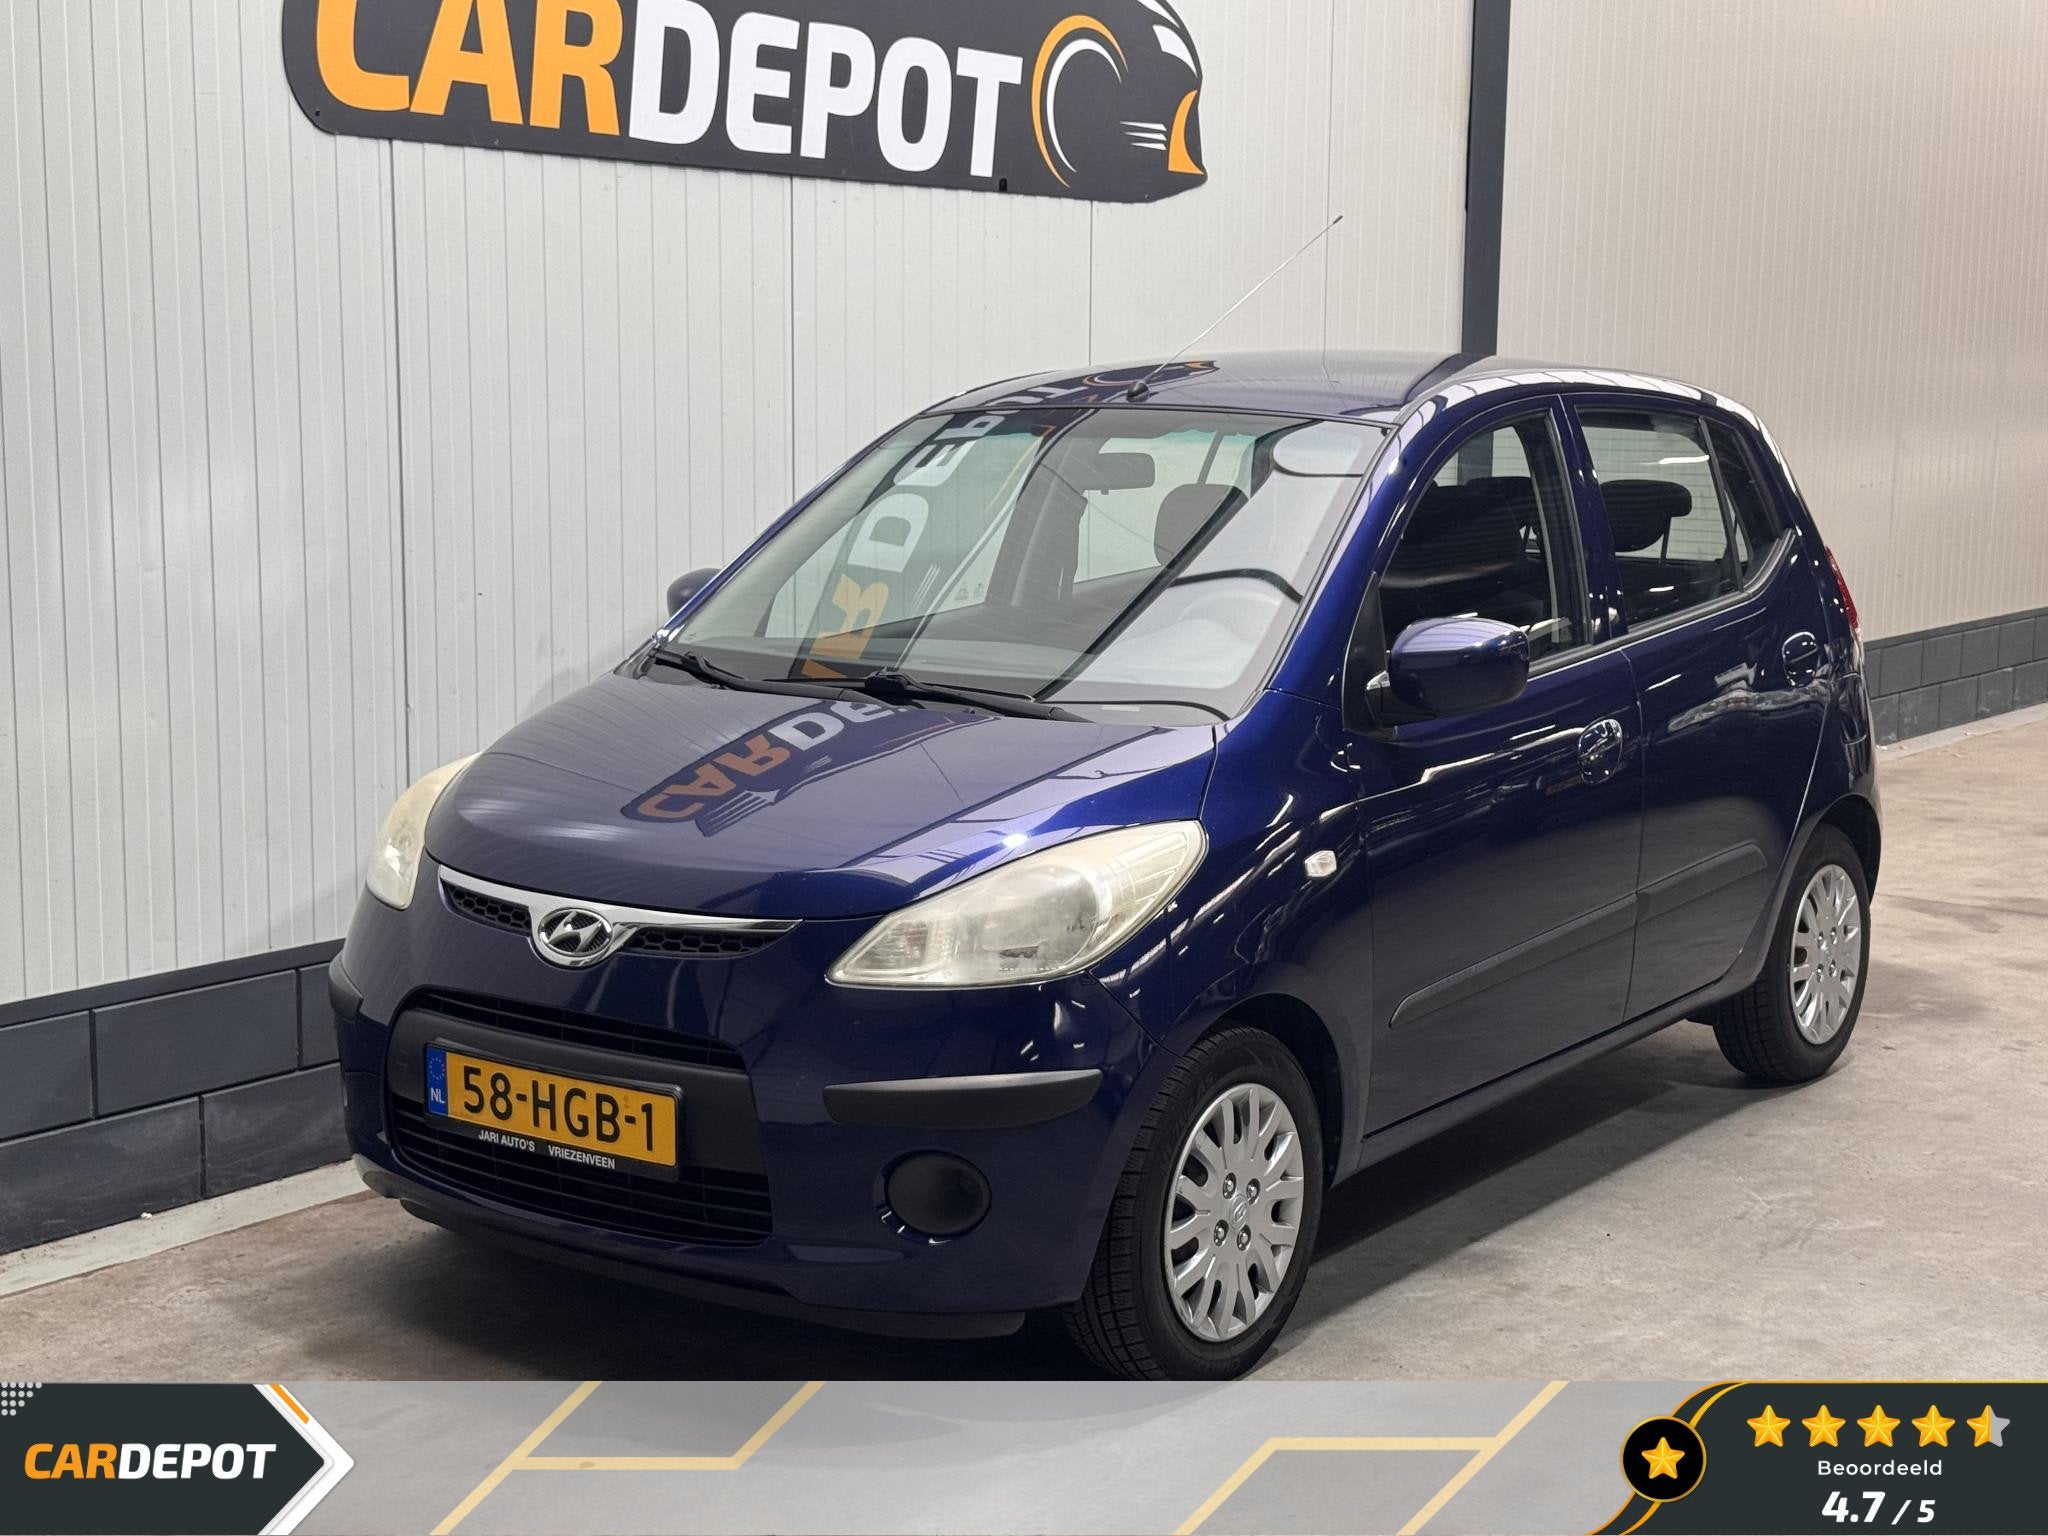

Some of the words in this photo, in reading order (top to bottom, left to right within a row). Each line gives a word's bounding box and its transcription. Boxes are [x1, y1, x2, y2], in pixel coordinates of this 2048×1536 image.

[316, 0, 1023, 179] CARDEPOT
[430, 1087, 446, 1104] NL
[463, 1064, 654, 1152] 58-HGB-1
[478, 1129, 500, 1144] JARI
[500, 1132, 536, 1152] AUTO'S
[548, 1144, 616, 1170] VRIEZENVEEN
